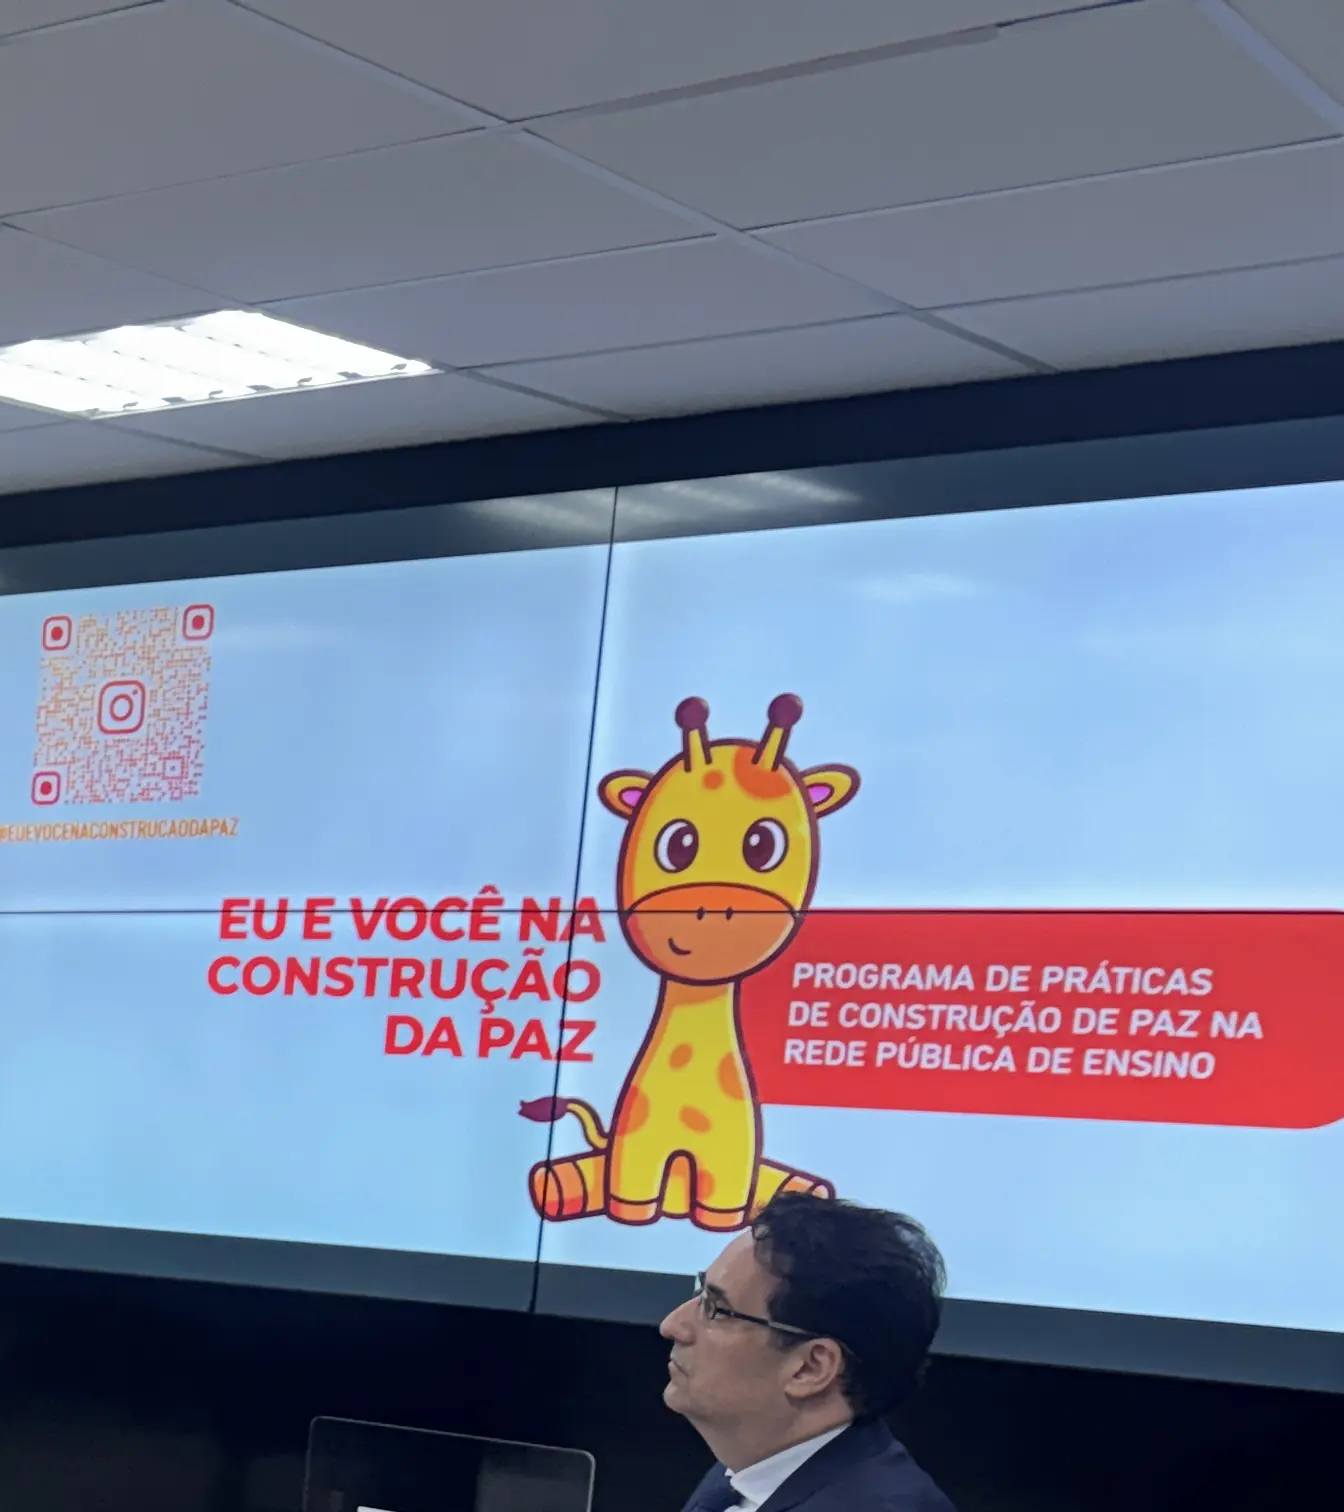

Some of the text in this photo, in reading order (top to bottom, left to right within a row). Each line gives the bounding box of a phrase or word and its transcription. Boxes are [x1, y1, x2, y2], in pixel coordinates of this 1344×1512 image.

[220, 884, 606, 942] EU E VOCÊ NA
[208, 947, 601, 1014] CONSTRUÇÃO
[792, 961, 1213, 996] PROGRAMA DE PRÁTICAS
[384, 1014, 596, 1062] DA PAZ
[788, 1001, 1264, 1040] DE CONSTRUÇÃO DE PAZ NA
[784, 1037, 1215, 1080] REDE PÚBLICA DE ENSINO
